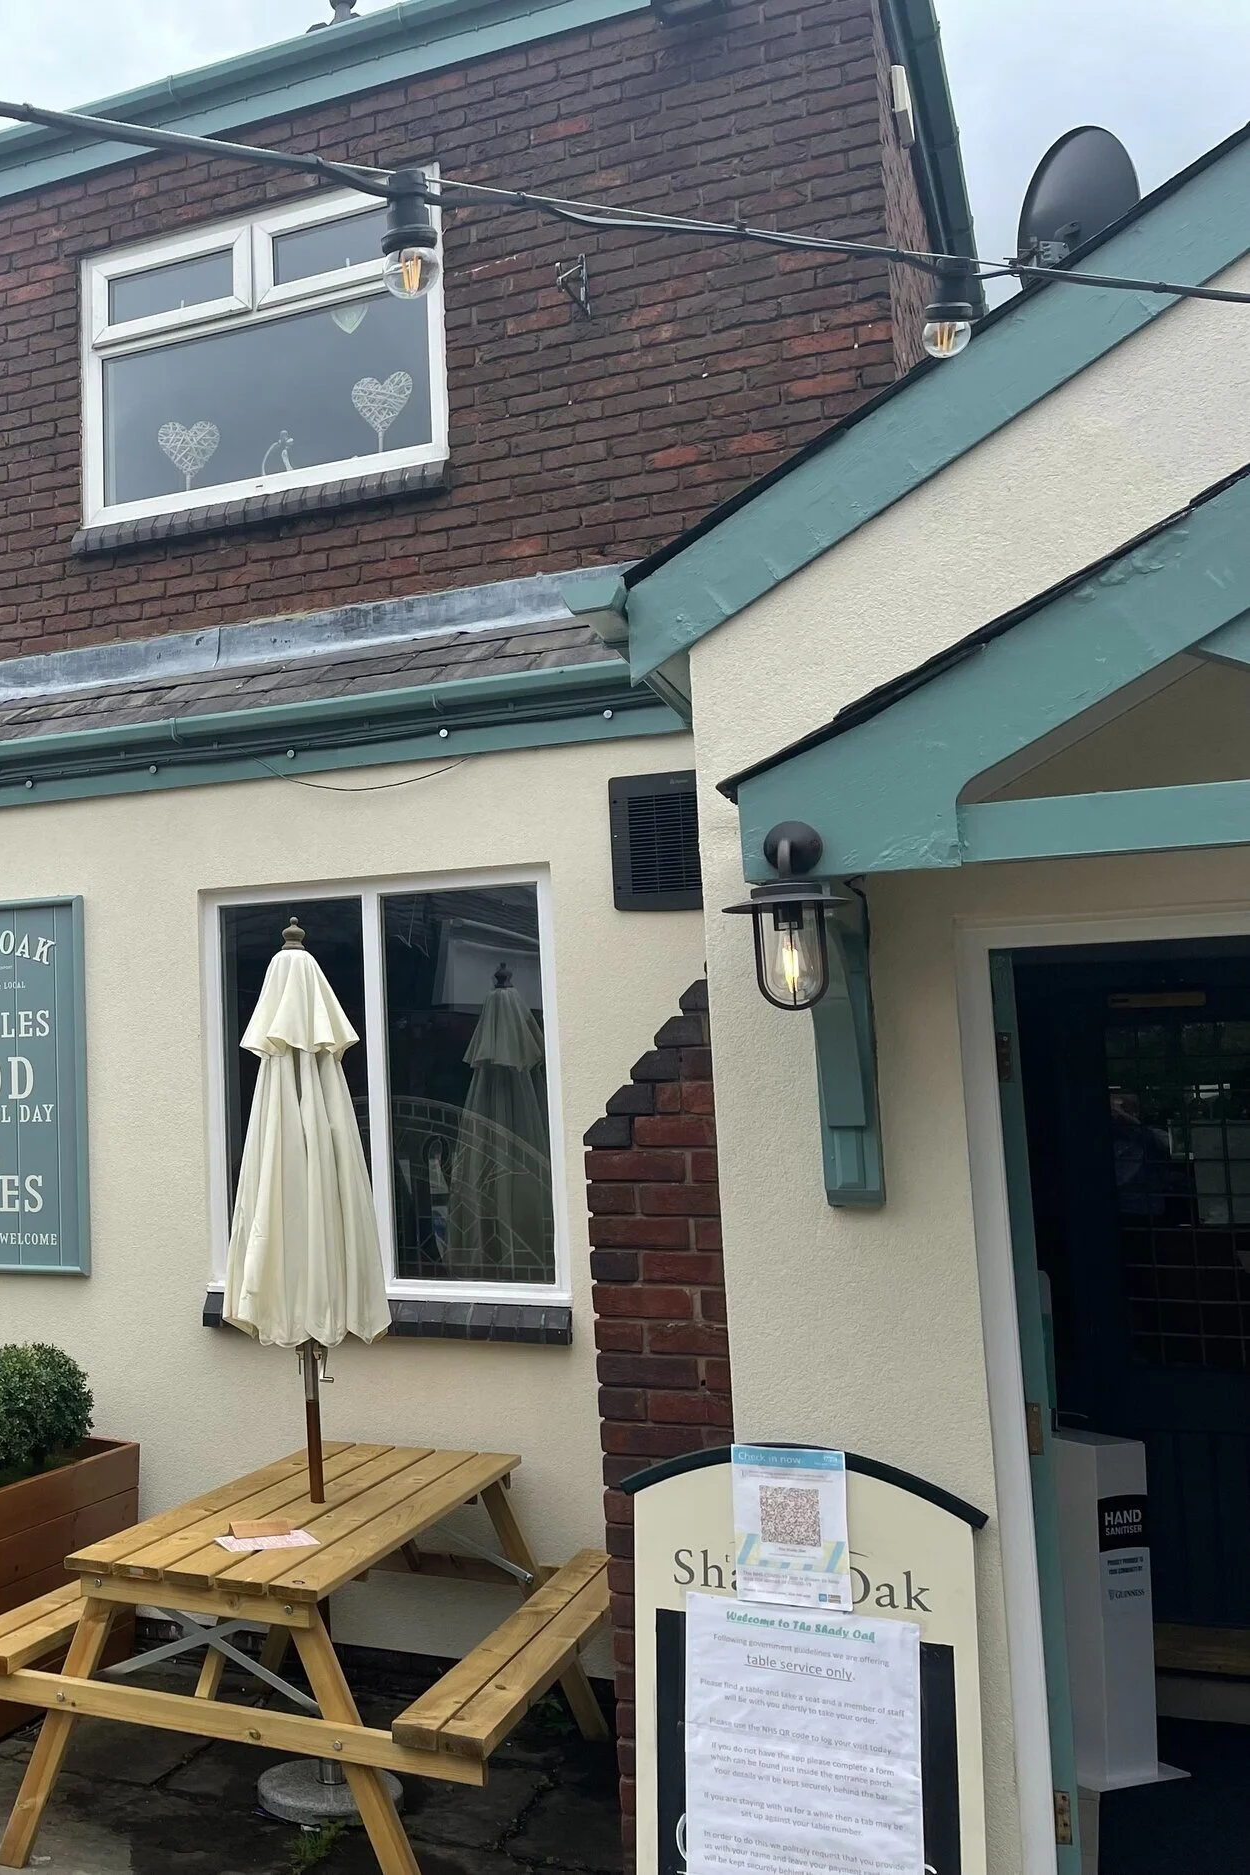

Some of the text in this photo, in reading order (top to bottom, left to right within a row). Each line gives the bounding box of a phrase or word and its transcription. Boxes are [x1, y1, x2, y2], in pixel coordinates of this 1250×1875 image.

[4, 981, 26, 990] LOCAL
[19, 1103, 55, 1123] DAY
[0, 1231, 58, 1246] WELCOME
[779, 1455, 801, 1465] now
[1104, 1509, 1142, 1526] HAND
[1105, 1524, 1143, 1536] SANITISER
[726, 1611, 876, 1643] Welcome to The Shady Oak
[713, 1634, 747, 1646] Following
[748, 1640, 792, 1651] government
[794, 1646, 832, 1658] guidelines
[846, 1654, 858, 1662] are
[860, 1655, 890, 1668] offering
[746, 1654, 856, 1681] table service only.
[700, 1678, 722, 1688] Please
[724, 1681, 738, 1690] find
[746, 1686, 764, 1695] table
[766, 1689, 779, 1697] and
[781, 1691, 797, 1700] take
[805, 1696, 820, 1704] seat
[822, 1698, 836, 1706] and
[844, 1702, 875, 1713] member
[887, 1710, 905, 1718] staff
[738, 1696, 747, 1704] be
[749, 1698, 765, 1707] with
[766, 1702, 780, 1710] you
[782, 1703, 808, 1714] shortly
[818, 1709, 834, 1718] take
[836, 1713, 853, 1721] your
[855, 1715, 878, 1724] order.
[710, 1717, 732, 1726] Please
[734, 1721, 746, 1729] use
[748, 1723, 760, 1732] the
[762, 1726, 778, 1734] NHS
[779, 1728, 790, 1737] QR
[792, 1731, 810, 1740] code
[821, 1736, 832, 1746] log
[834, 1740, 852, 1748] your
[853, 1743, 868, 1752] visit
[710, 1754, 731, 1763] which
[733, 1758, 746, 1766] can
[748, 1759, 757, 1767] be
[759, 1760, 780, 1770] found
[782, 1764, 795, 1773] just
[796, 1768, 818, 1776] inside
[820, 1770, 833, 1779] the
[834, 1774, 868, 1784] entrance
[718, 1744, 731, 1752] you
[744, 1748, 756, 1756] not
[758, 1749, 776, 1758] have
[778, 1752, 790, 1760] the
[792, 1755, 806, 1764] app
[806, 1757, 831, 1766] please
[832, 1760, 867, 1772] complete
[876, 1767, 894, 1776] form
[714, 1767, 874, 1798] Your details will be kept securely behind the
[710, 1794, 724, 1802] you
[726, 1796, 737, 1804] are
[740, 1798, 765, 1810] staying
[766, 1802, 782, 1811] with
[794, 1806, 804, 1814] for
[814, 1810, 834, 1819] while
[836, 1814, 852, 1822] then
[861, 1818, 874, 1826] tab
[876, 1821, 892, 1830] may
[894, 1823, 904, 1831] be
[740, 1810, 752, 1818] set
[754, 1812, 763, 1820] up
[765, 1814, 791, 1825] against
[792, 1819, 809, 1828] your
[811, 1822, 830, 1831] table
[704, 1830, 711, 1838] In
[712, 1832, 732, 1840] order
[734, 1836, 742, 1844] to
[744, 1836, 754, 1845] do
[755, 1839, 768, 1848] this
[782, 1844, 810, 1856] politely
[812, 1850, 840, 1860] request
[842, 1854, 858, 1863] that
[860, 1858, 874, 1867] you
[876, 1860, 905, 1871] provide
[704, 1854, 716, 1862] will
[718, 1856, 728, 1864] be
[729, 1858, 746, 1868] kept
[747, 1862, 777, 1875] securely
[714, 1844, 730, 1853] with
[732, 1848, 748, 1856] your
[750, 1851, 771, 1860] name
[772, 1854, 786, 1863] and
[789, 1857, 808, 1866] leave
[810, 1862, 826, 1870] your
[828, 1865, 861, 1875] payment
